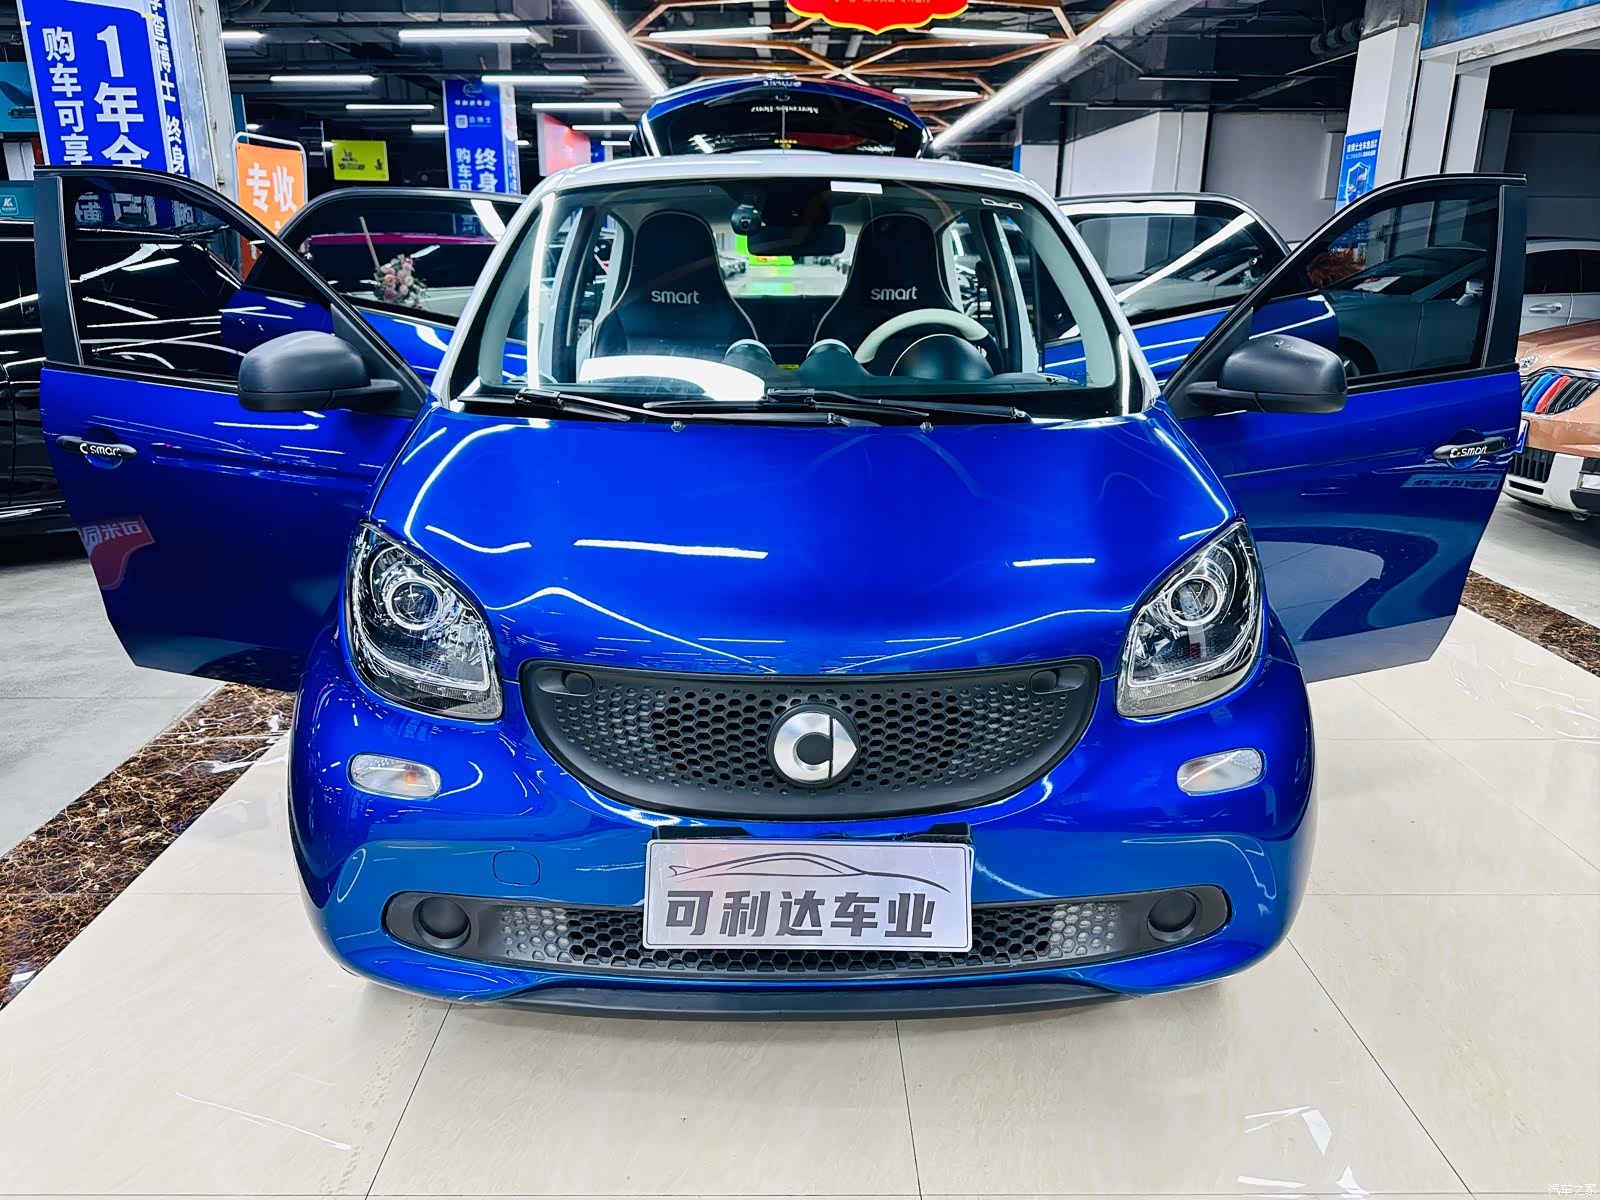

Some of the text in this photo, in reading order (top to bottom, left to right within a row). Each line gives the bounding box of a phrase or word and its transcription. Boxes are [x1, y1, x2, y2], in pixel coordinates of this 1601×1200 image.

[42, 26, 93, 165] 购车可享
[94, 25, 150, 168] 1年全
[246, 161, 298, 213] 专收
[651, 290, 700, 305] smart
[870, 286, 918, 300] smart
[1460, 445, 1488, 457] smart
[665, 890, 935, 938] 可利达车业
